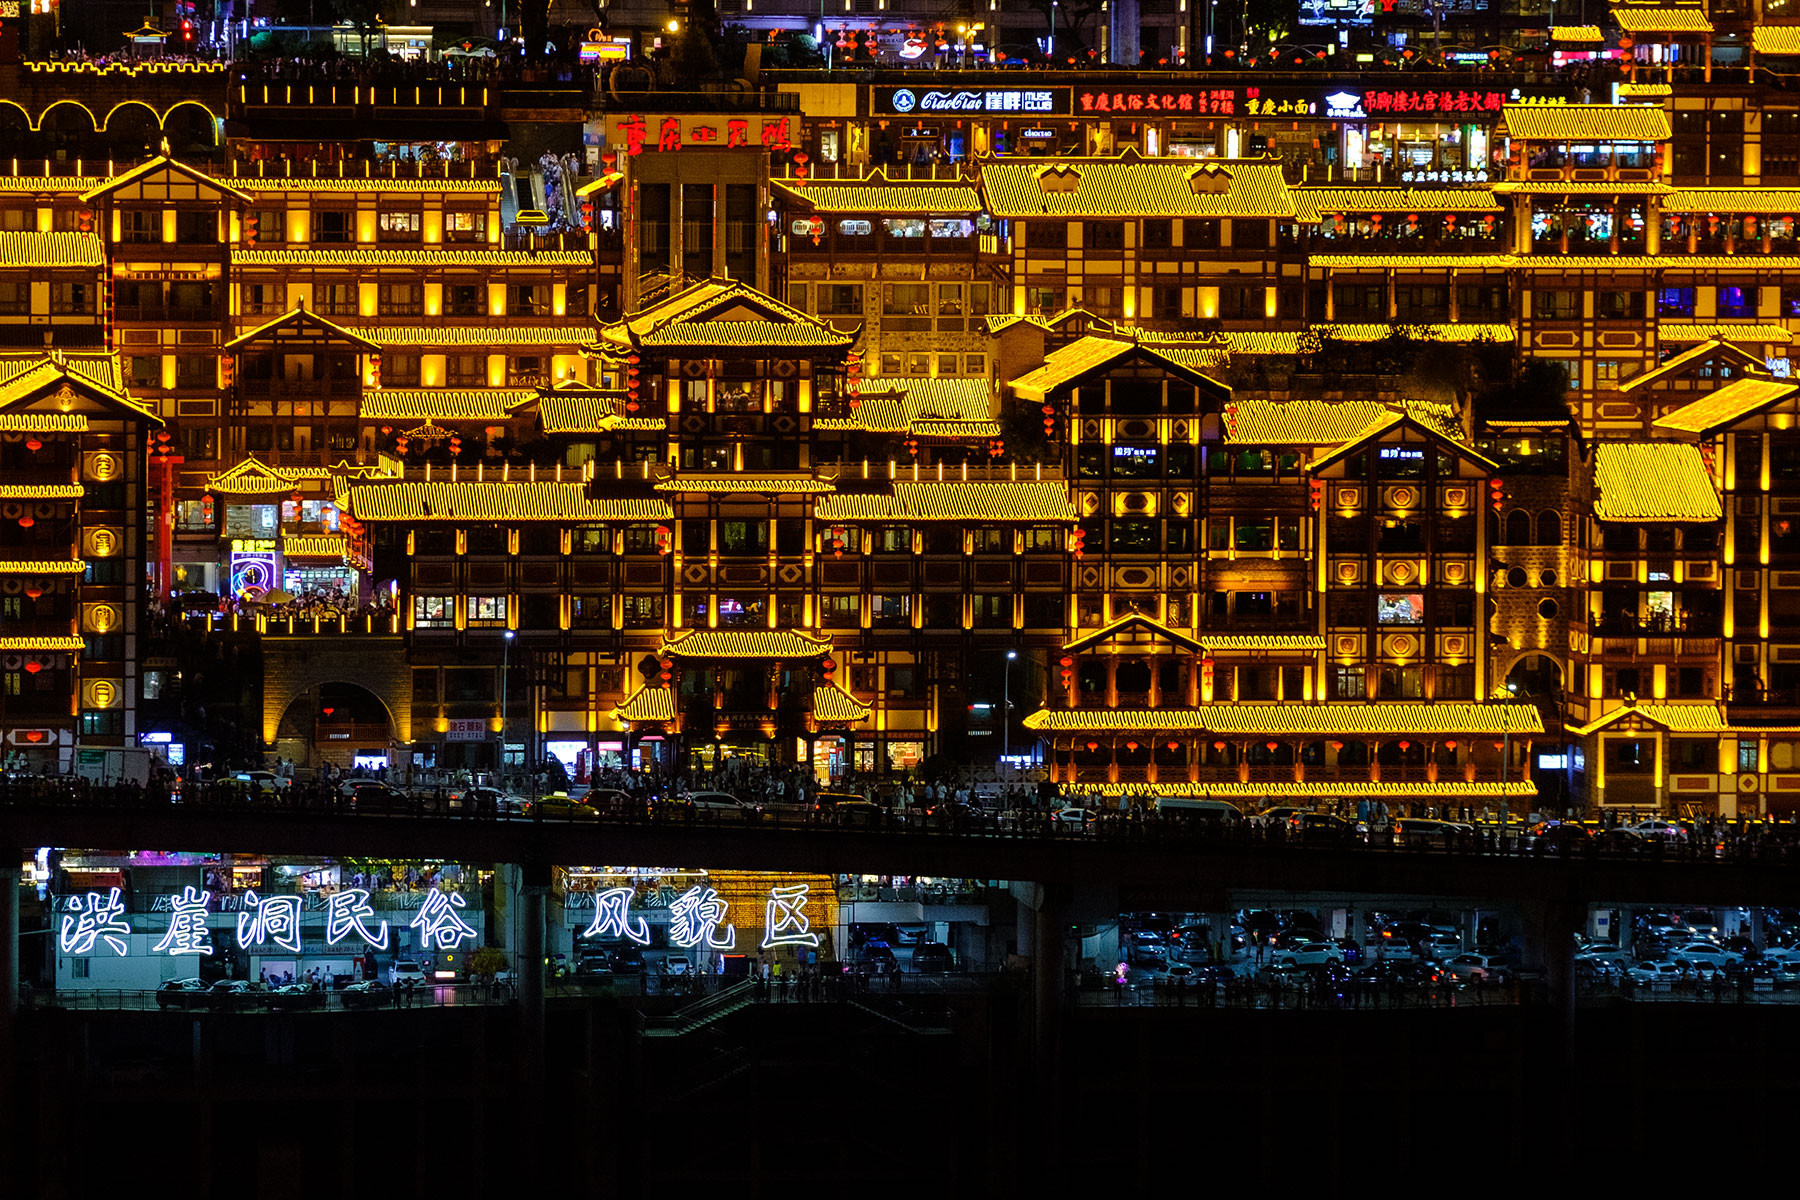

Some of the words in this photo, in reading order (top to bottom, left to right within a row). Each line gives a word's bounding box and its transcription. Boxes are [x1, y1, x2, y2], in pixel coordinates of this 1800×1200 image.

[921, 91, 982, 110] CiaoCiao
[1025, 91, 1053, 101] MUSIC
[1025, 101, 1053, 111] CLUB
[60, 886, 478, 956] 洪崖洞民俗
[583, 884, 819, 950] 风貌区
